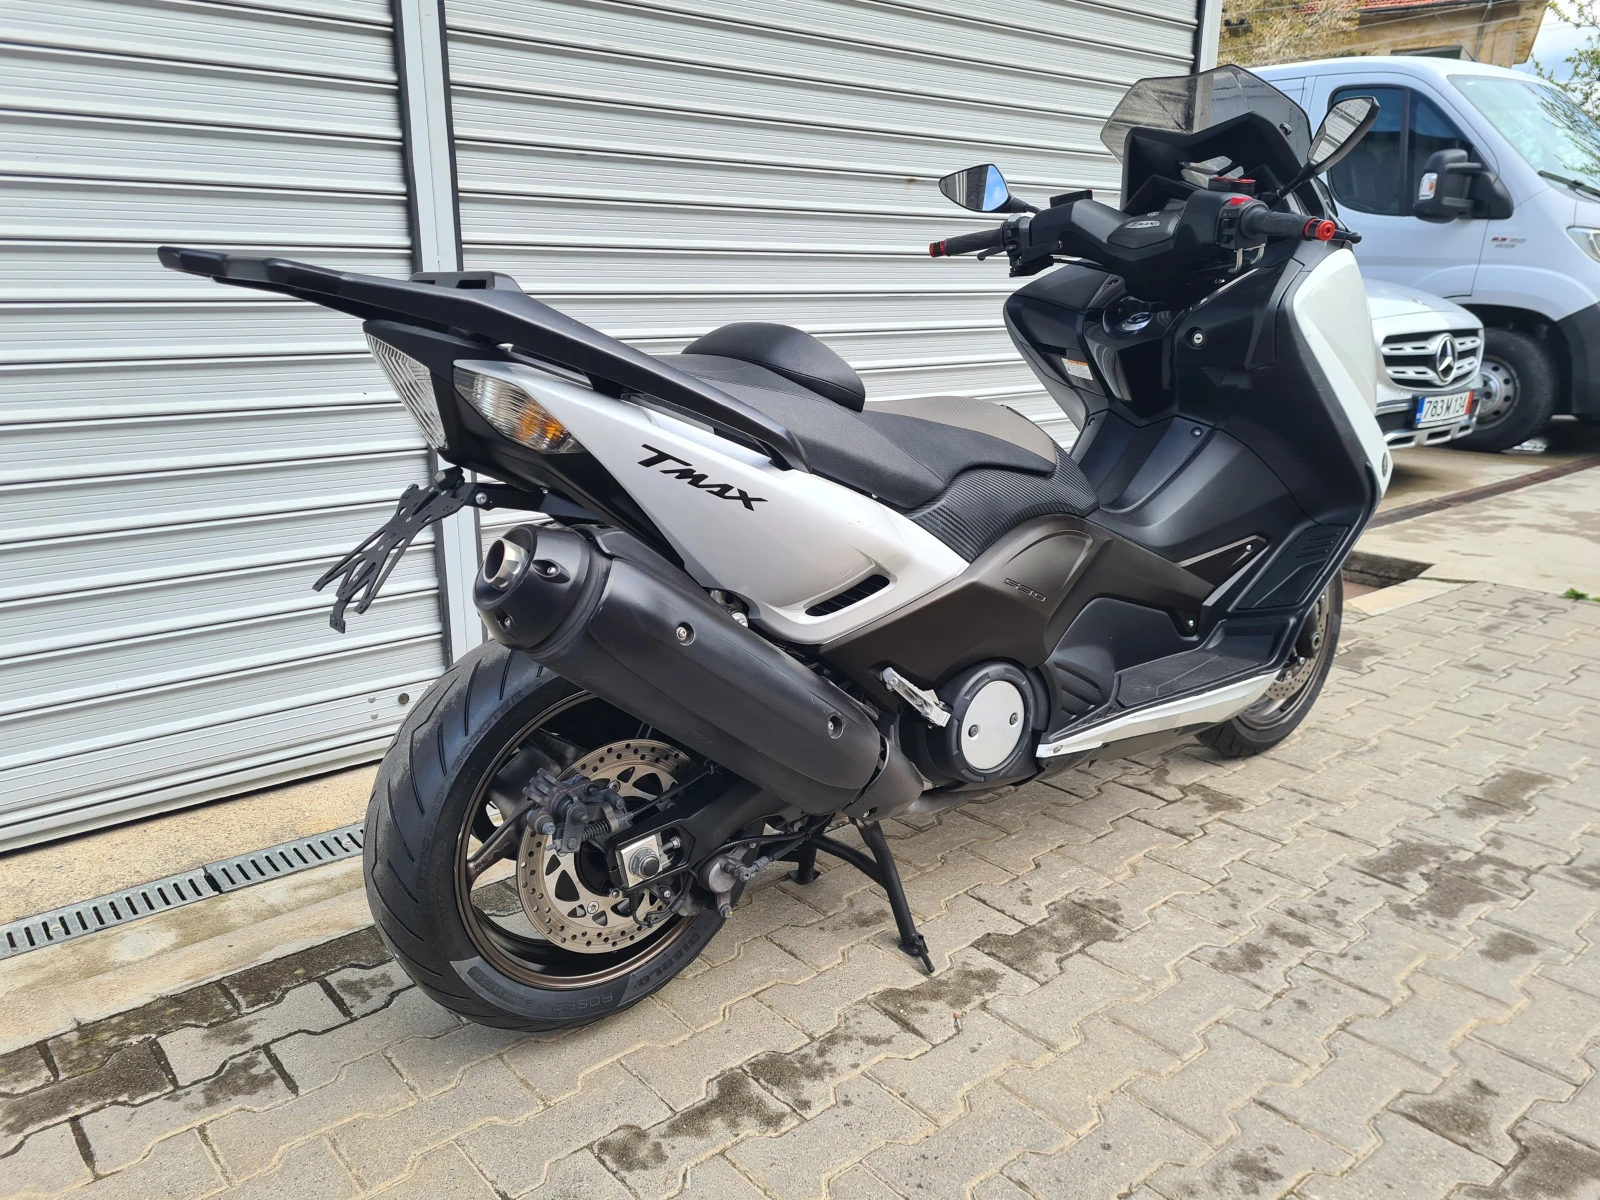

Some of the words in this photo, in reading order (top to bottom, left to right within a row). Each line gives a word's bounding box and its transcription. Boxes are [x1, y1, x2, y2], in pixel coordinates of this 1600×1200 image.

[637, 443, 768, 511] TMAX
[1003, 577, 1047, 602] 530
[452, 689, 525, 772] SCOOTER
[637, 932, 701, 986] DIABLO
[551, 992, 613, 1011] ROSSO
